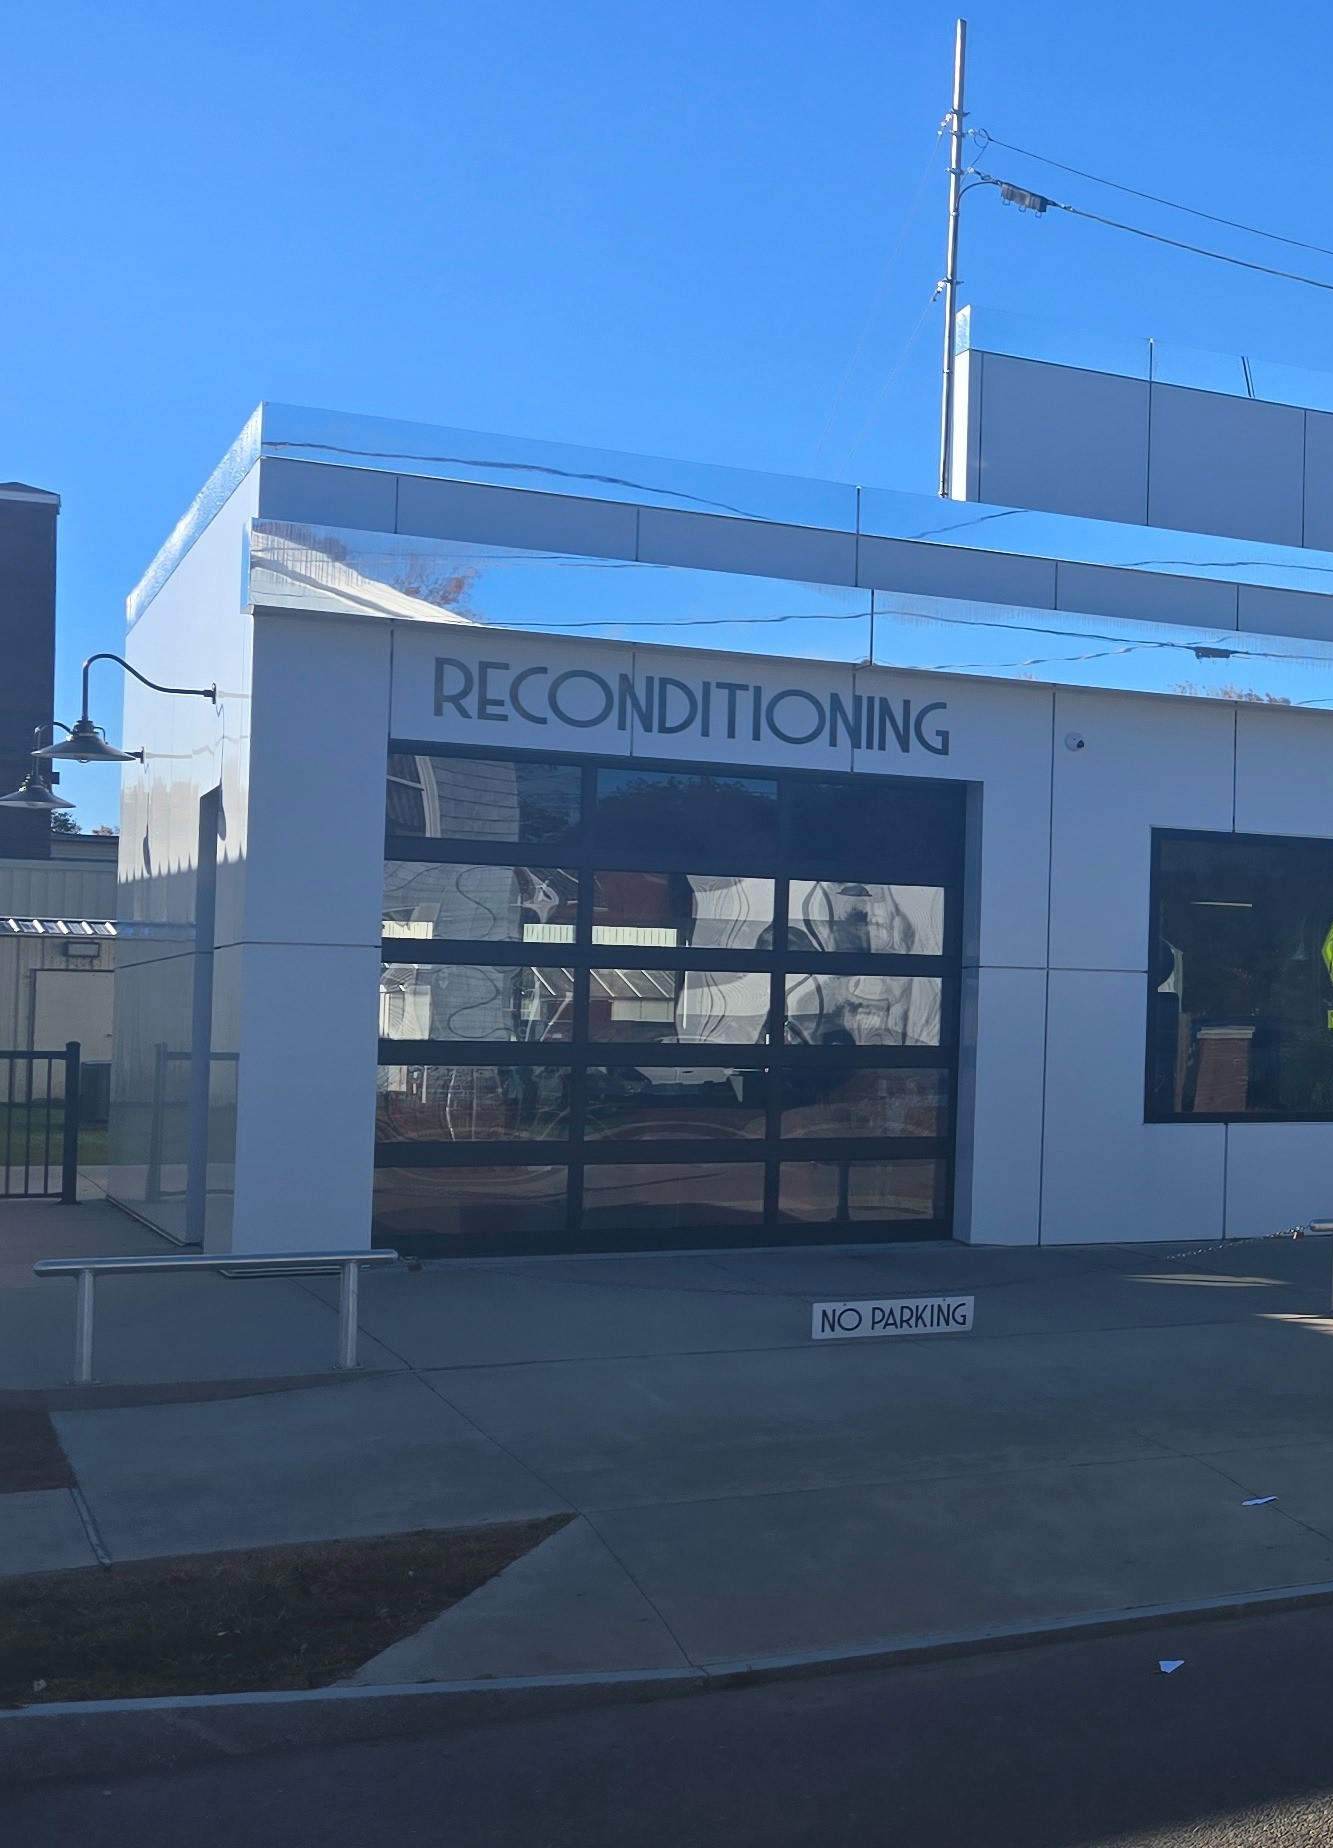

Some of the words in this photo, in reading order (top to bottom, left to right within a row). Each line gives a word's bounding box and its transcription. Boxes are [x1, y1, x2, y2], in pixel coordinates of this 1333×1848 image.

[433, 656, 950, 756] RECONDITIONING
[820, 1307, 863, 1333] NO
[870, 1302, 967, 1331] PARKING
